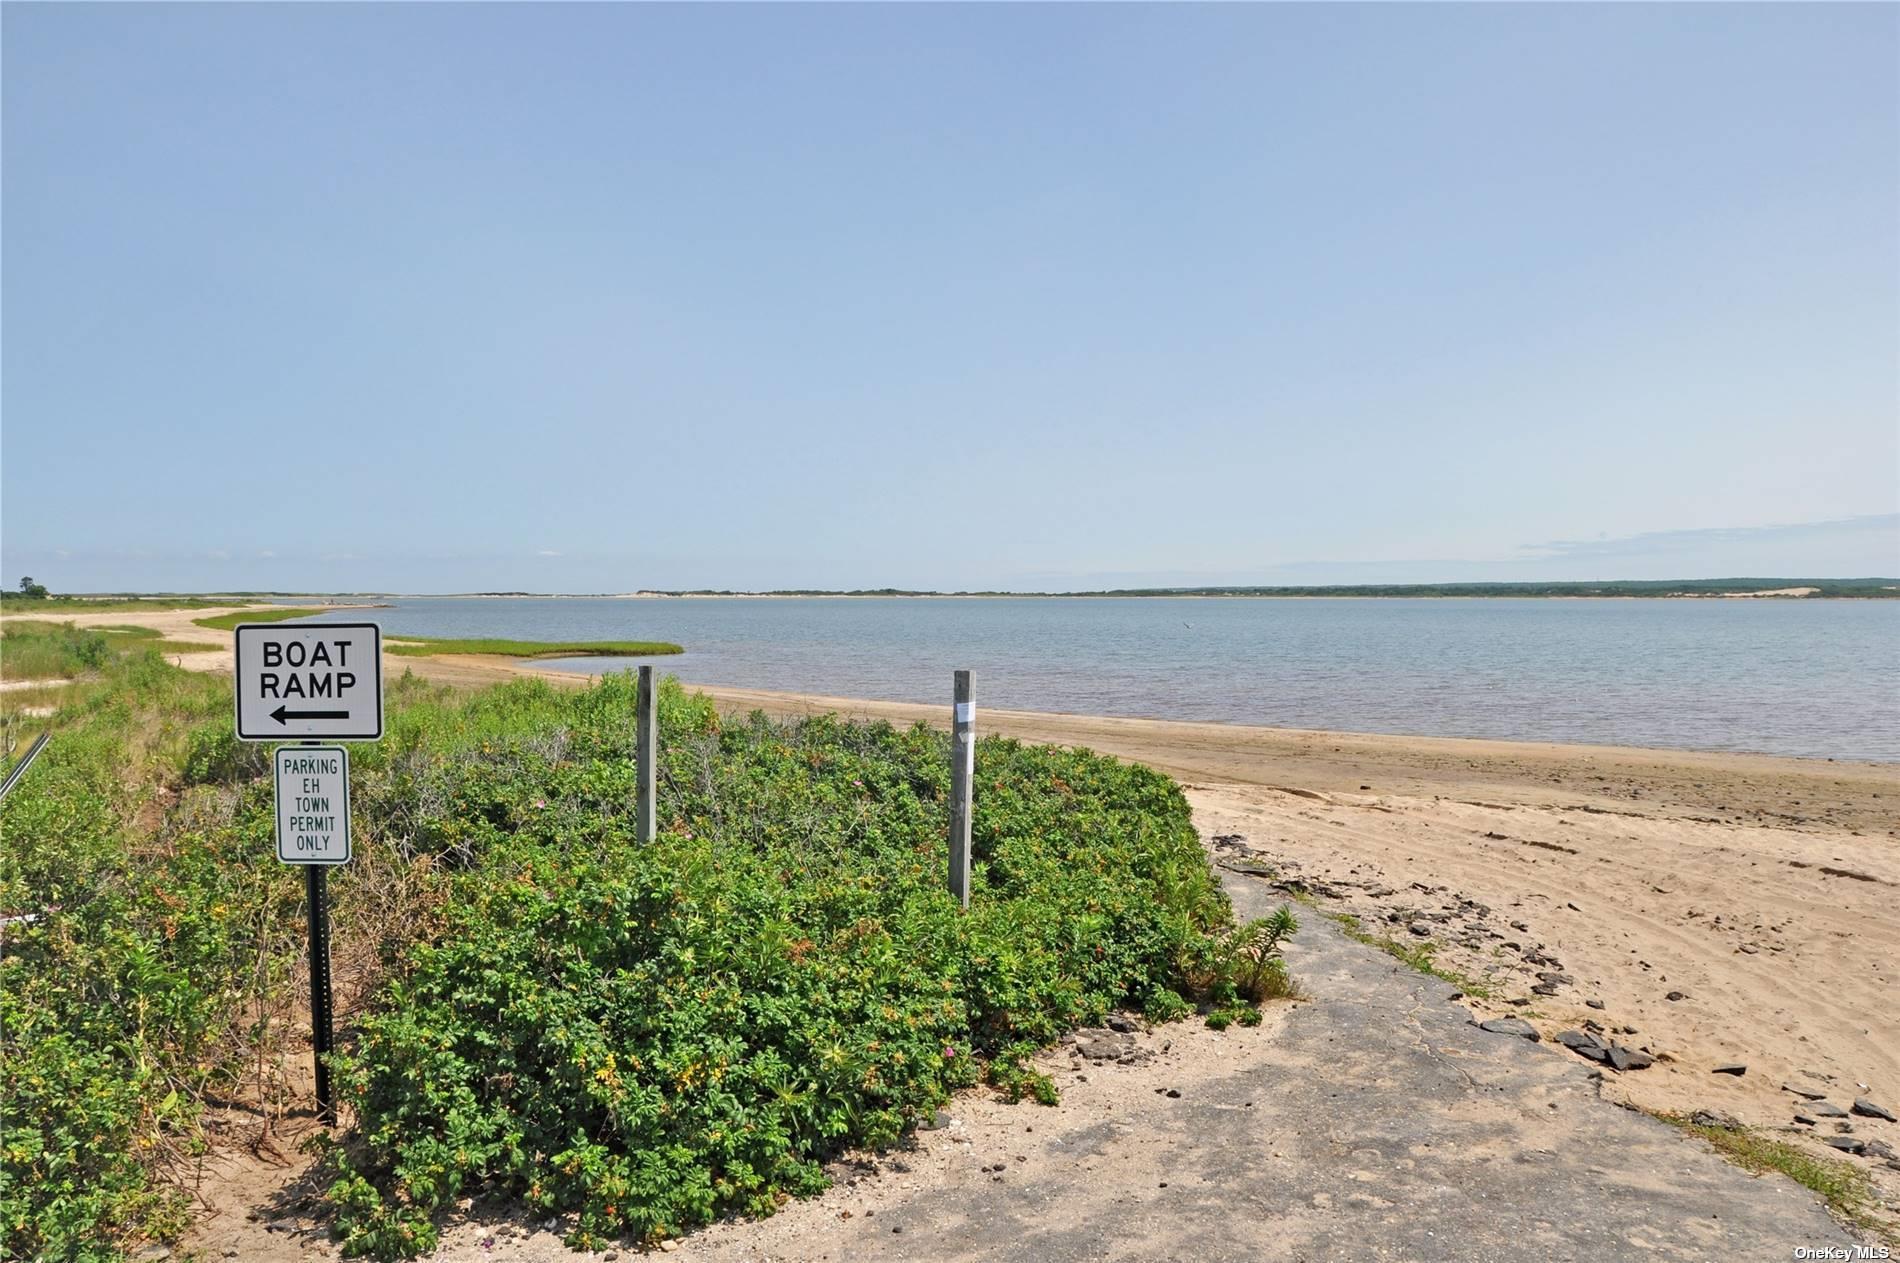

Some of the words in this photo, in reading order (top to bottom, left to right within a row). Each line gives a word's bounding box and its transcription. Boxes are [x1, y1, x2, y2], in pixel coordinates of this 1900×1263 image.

[263, 641, 352, 668] BOAT
[260, 672, 356, 699] RAMP
[284, 759, 338, 775] PARKING
[303, 778, 320, 794] EH
[295, 797, 329, 813] TOWN
[290, 816, 335, 832] PERMIT
[296, 835, 330, 851] ONLY
